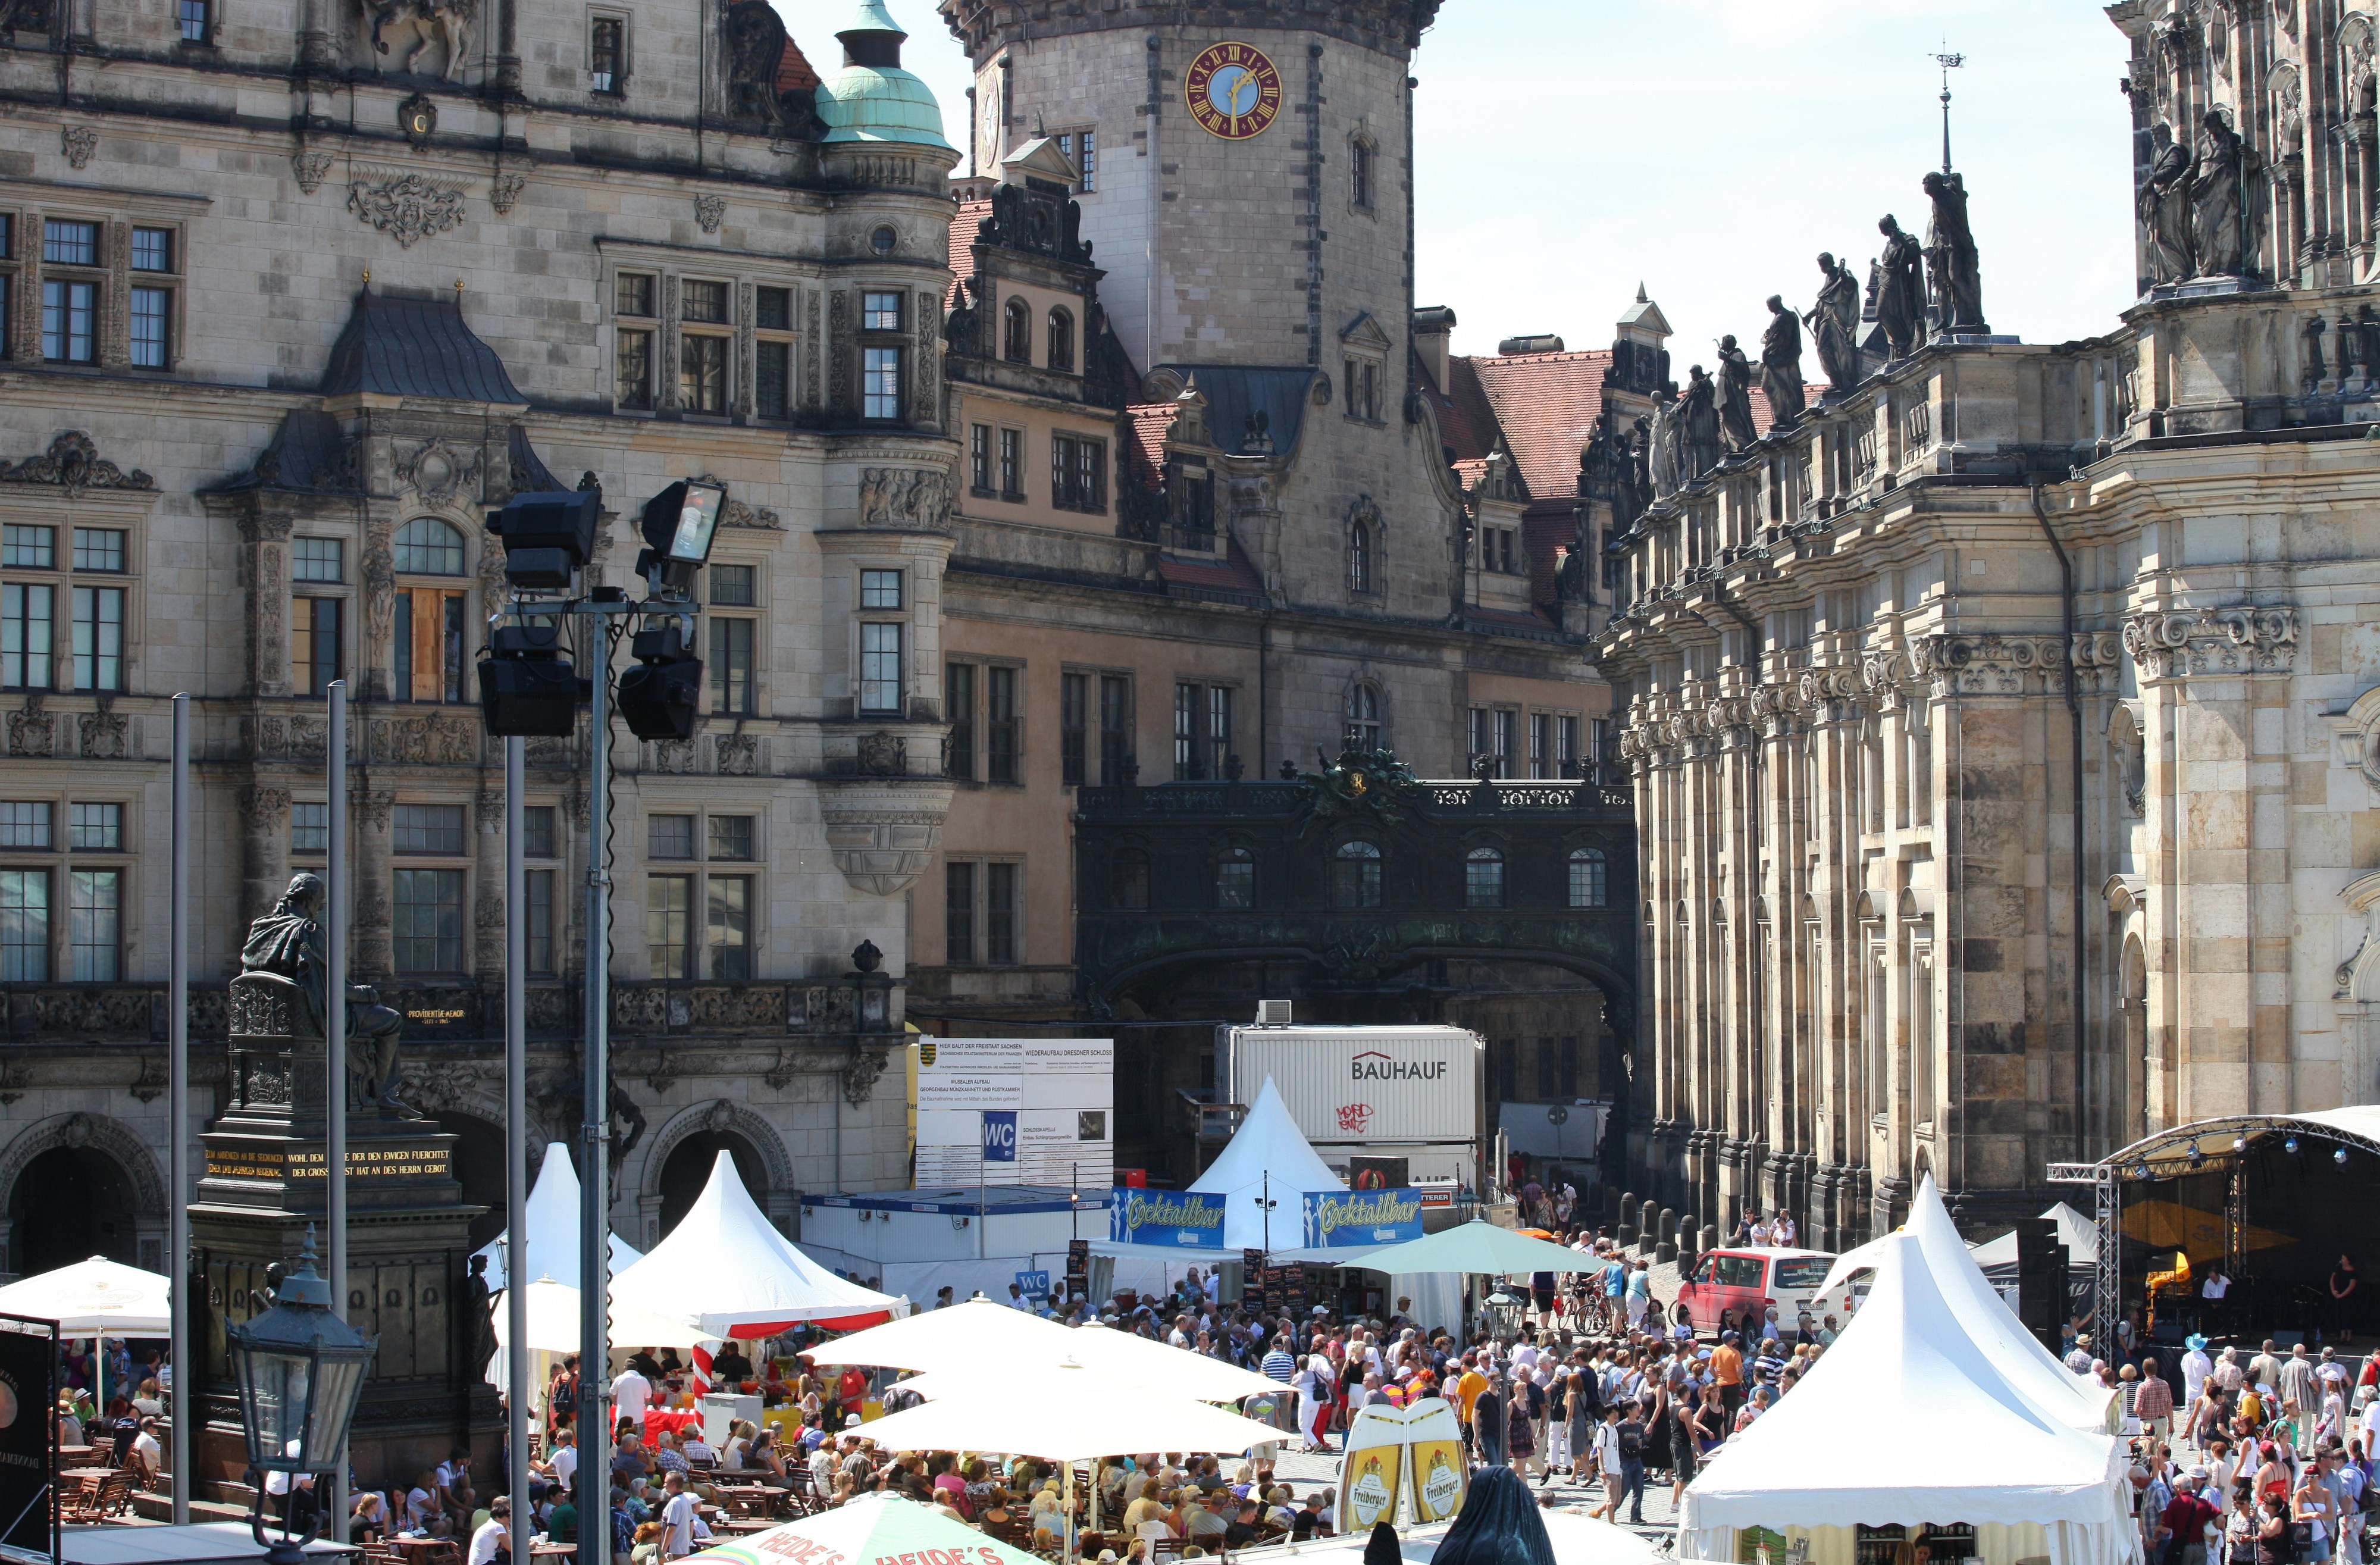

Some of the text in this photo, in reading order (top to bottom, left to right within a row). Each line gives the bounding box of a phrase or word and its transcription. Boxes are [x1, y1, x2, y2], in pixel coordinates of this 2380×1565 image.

[1208, 49, 1222, 66] XI
[1229, 45, 1240, 61] XII
[1194, 64, 1210, 77] X
[1258, 67, 1273, 79] II
[1189, 84, 1205, 93] IX
[1263, 87, 1279, 98] III
[414, 115, 426, 133] G
[1248, 116, 1258, 132] V
[1352, 1062, 1446, 1079] BAUHAUF
[985, 1123, 1014, 1147] WC
[288, 1154, 308, 1163] WOHL
[310, 1153, 324, 1162] DEM
[352, 1152, 365, 1161] DER
[368, 1152, 381, 1161] DEN
[384, 1151, 409, 1160] EWIGEN
[412, 1150, 450, 1159] FUERCHTET
[293, 1168, 305, 1177] DER
[308, 1168, 328, 1176] GROSS
[357, 1166, 369, 1175] HAT
[371, 1166, 381, 1175] AN
[383, 1166, 396, 1175] DES
[399, 1165, 421, 1174] HERRN
[424, 1165, 447, 1173] GEBOT.
[1128, 1193, 1224, 1231] Cocktailbar
[1321, 1191, 1420, 1235] Cocktailbar
[1019, 1274, 1047, 1289] WC
[1613, 1438, 1618, 1451] 4
[1354, 1488, 1386, 1507] Freiberger
[1426, 1479, 1458, 1500] Freiberger
